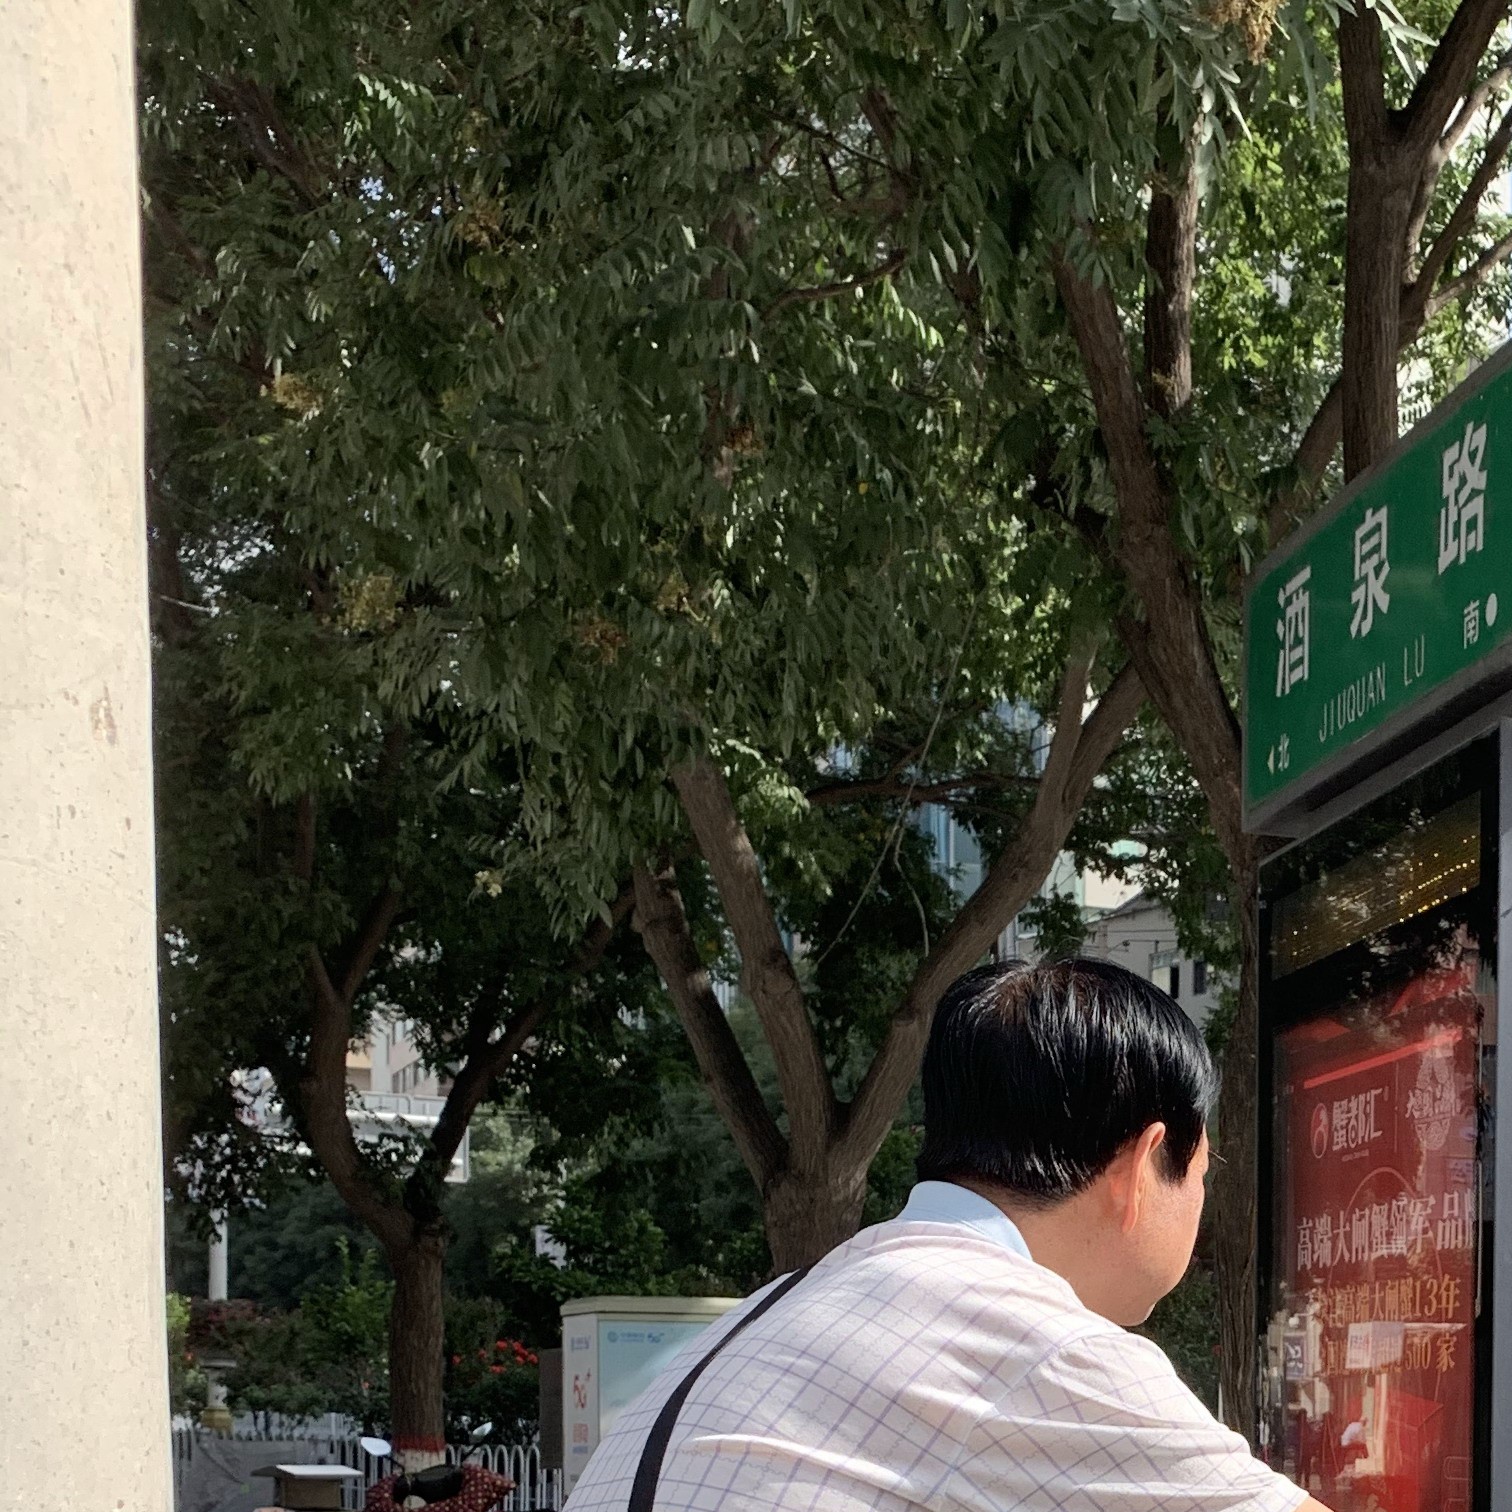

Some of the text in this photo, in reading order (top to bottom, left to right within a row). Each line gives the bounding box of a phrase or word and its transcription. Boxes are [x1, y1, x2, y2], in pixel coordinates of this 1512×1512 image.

[1275, 421, 1488, 698] 酒泉路
[1463, 600, 1481, 650] 南
[1318, 634, 1425, 744] JIUQUAN LU
[1278, 733, 1290, 772] 北
